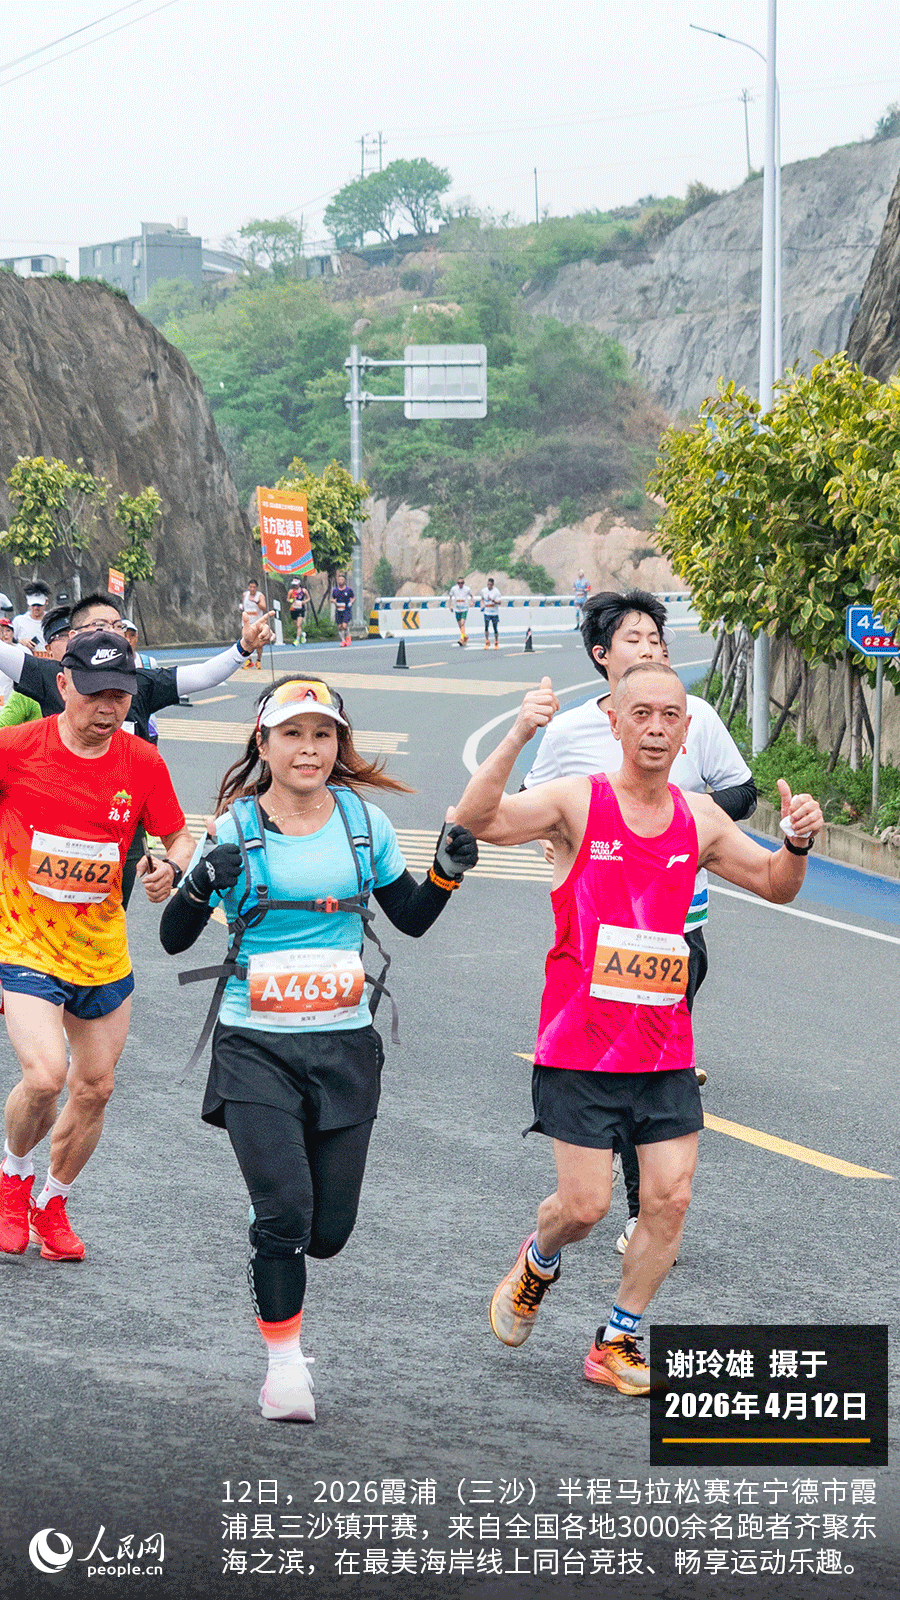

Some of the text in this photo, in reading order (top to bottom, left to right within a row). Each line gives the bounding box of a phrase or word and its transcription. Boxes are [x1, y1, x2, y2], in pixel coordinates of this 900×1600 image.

[275, 538, 292, 556] 2:15
[95, 648, 117, 659] NIKE
[590, 840, 610, 848] 2026
[590, 854, 623, 862] MARATHON
[36, 855, 111, 884] A3462
[603, 950, 684, 983] A4392
[260, 972, 355, 1002] A4639
